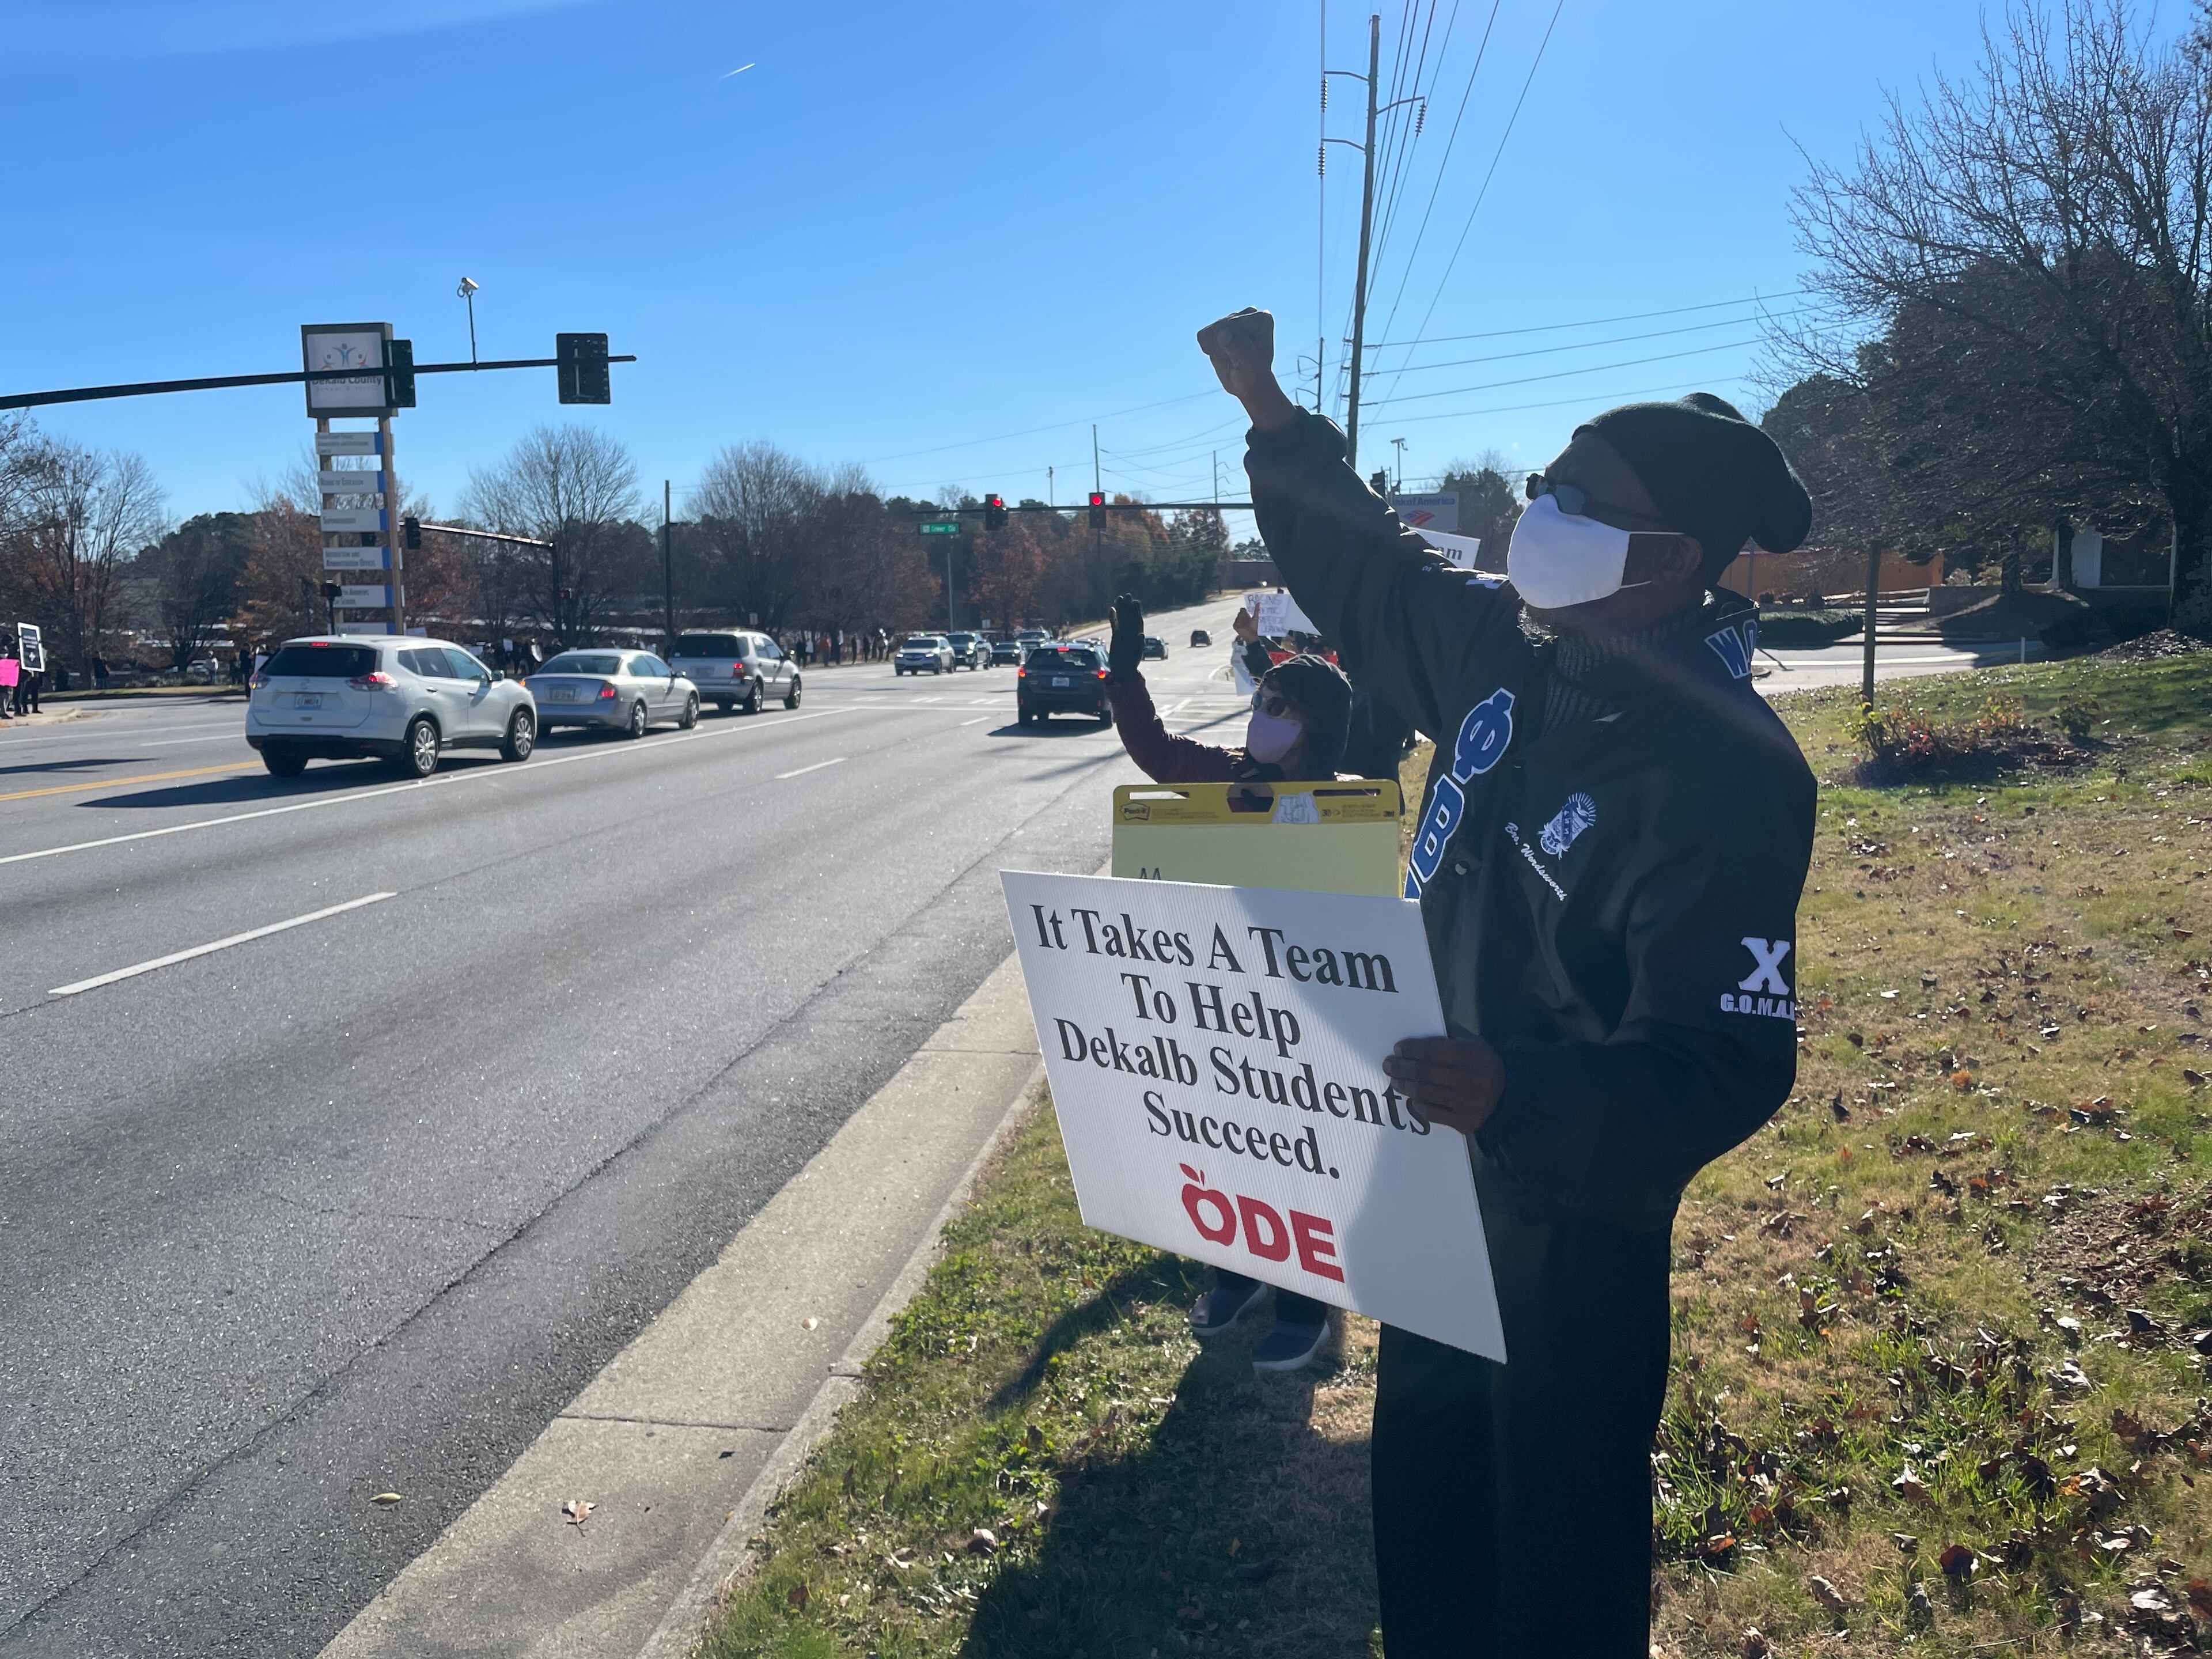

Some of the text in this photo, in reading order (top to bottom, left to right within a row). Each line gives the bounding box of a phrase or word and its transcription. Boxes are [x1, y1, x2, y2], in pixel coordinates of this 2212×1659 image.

[1416, 497, 1455, 505] America
[1029, 904, 1399, 993] It Takes A Team
[1738, 937, 1790, 995] X
[1120, 972, 1301, 1059] To Help
[1052, 1018, 1431, 1137] Dekalb Students
[1143, 1090, 1340, 1180] Succeed.
